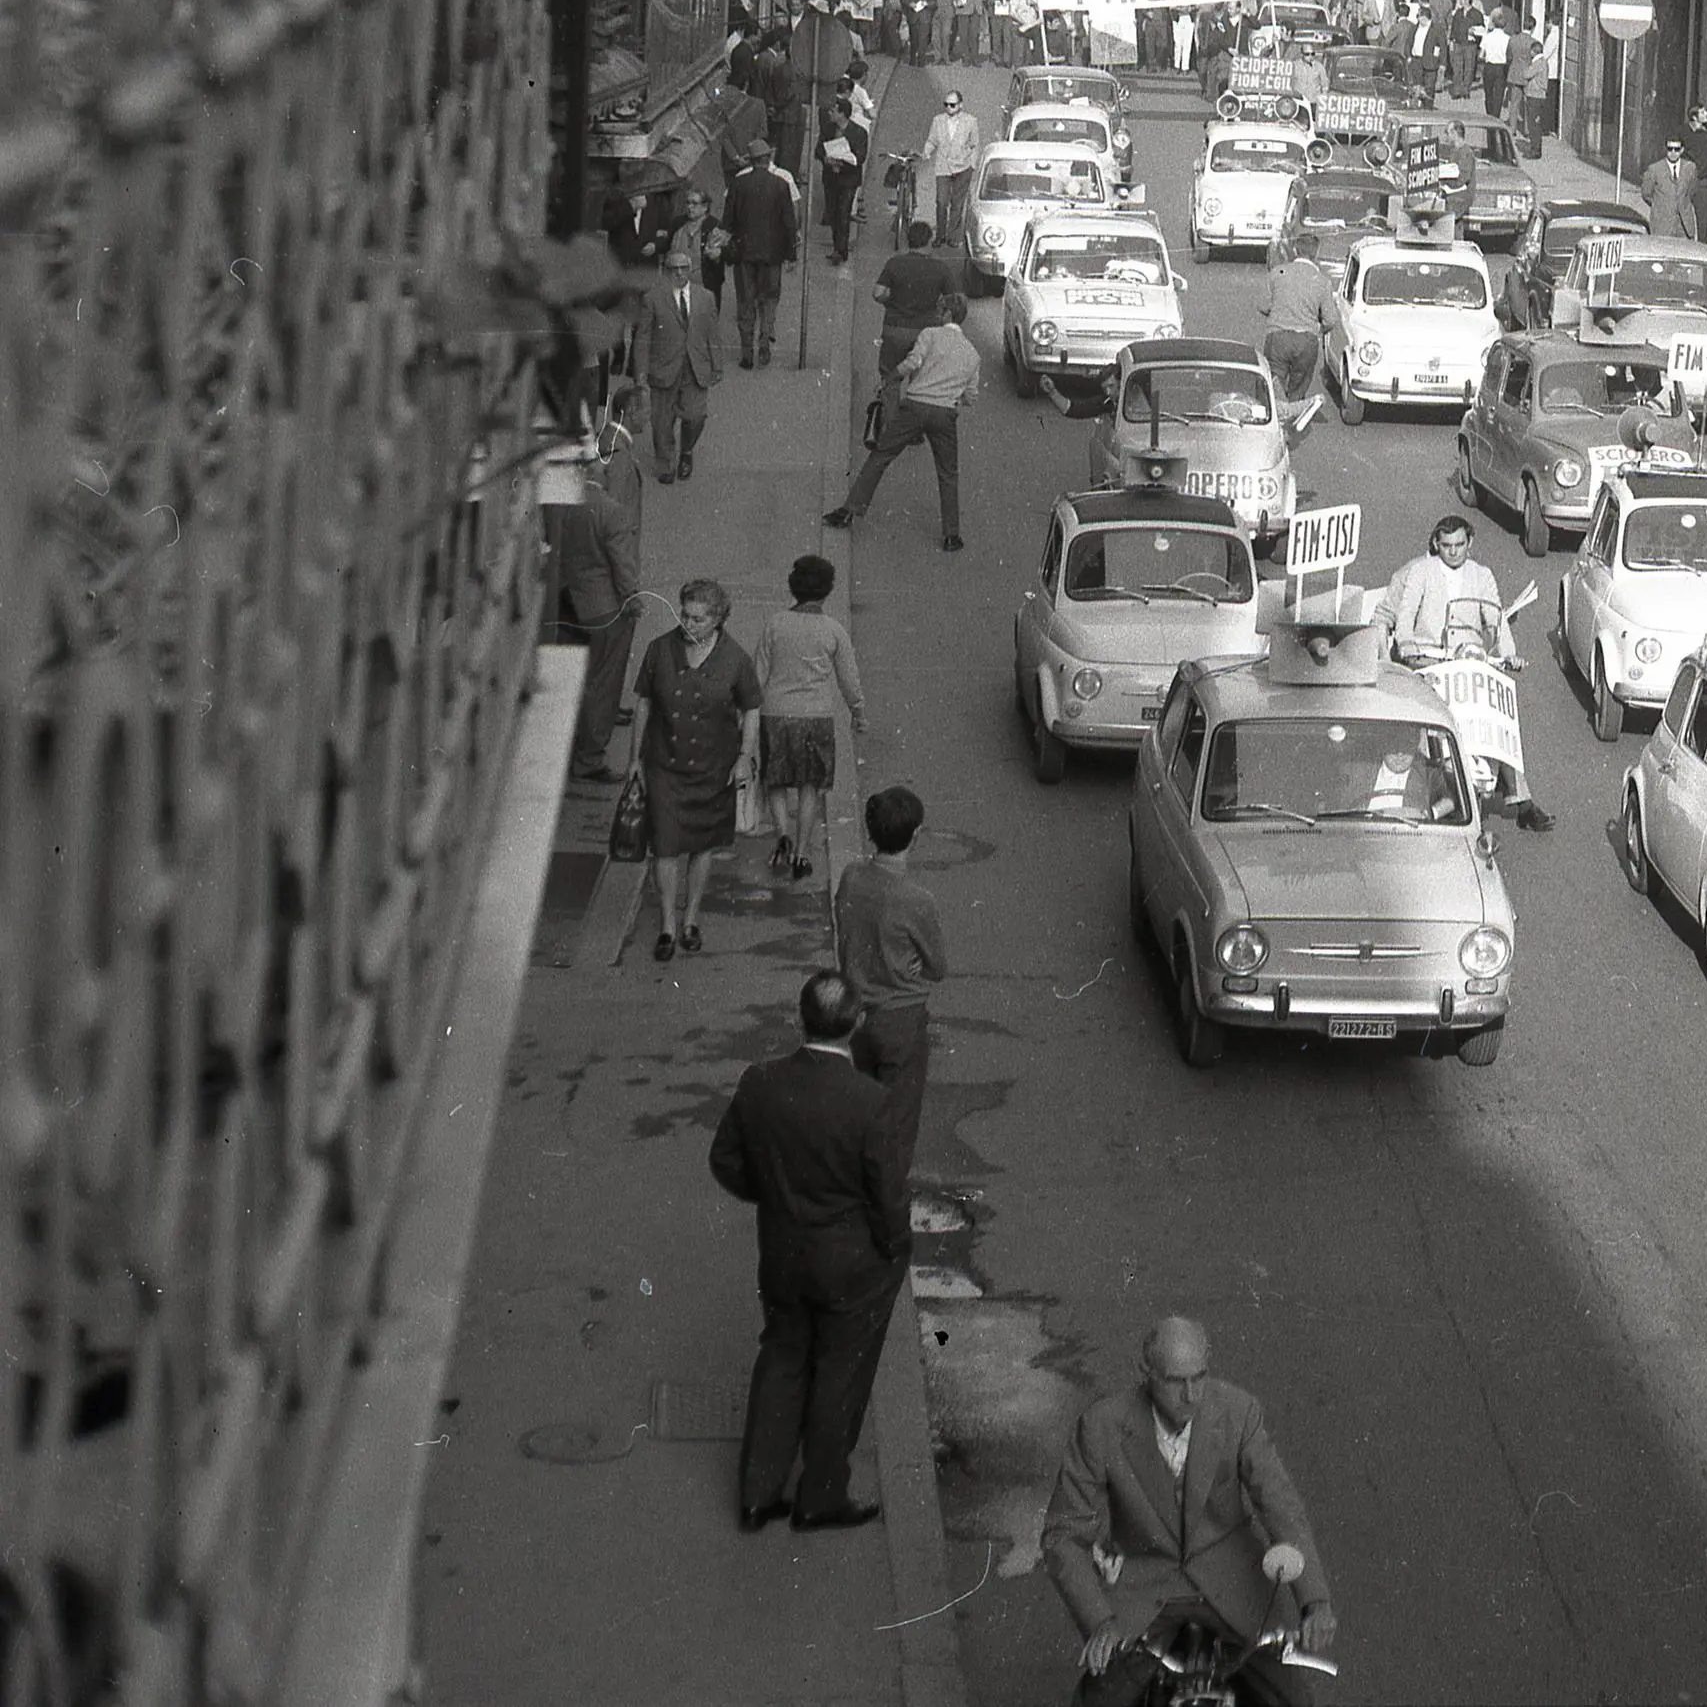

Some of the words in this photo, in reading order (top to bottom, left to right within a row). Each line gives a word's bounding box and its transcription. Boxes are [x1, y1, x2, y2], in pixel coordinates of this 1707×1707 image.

[1232, 56, 1293, 75] SCIOPERO
[1319, 95, 1386, 116] SCIOPERO
[1595, 447, 1686, 463] SCIOERO
